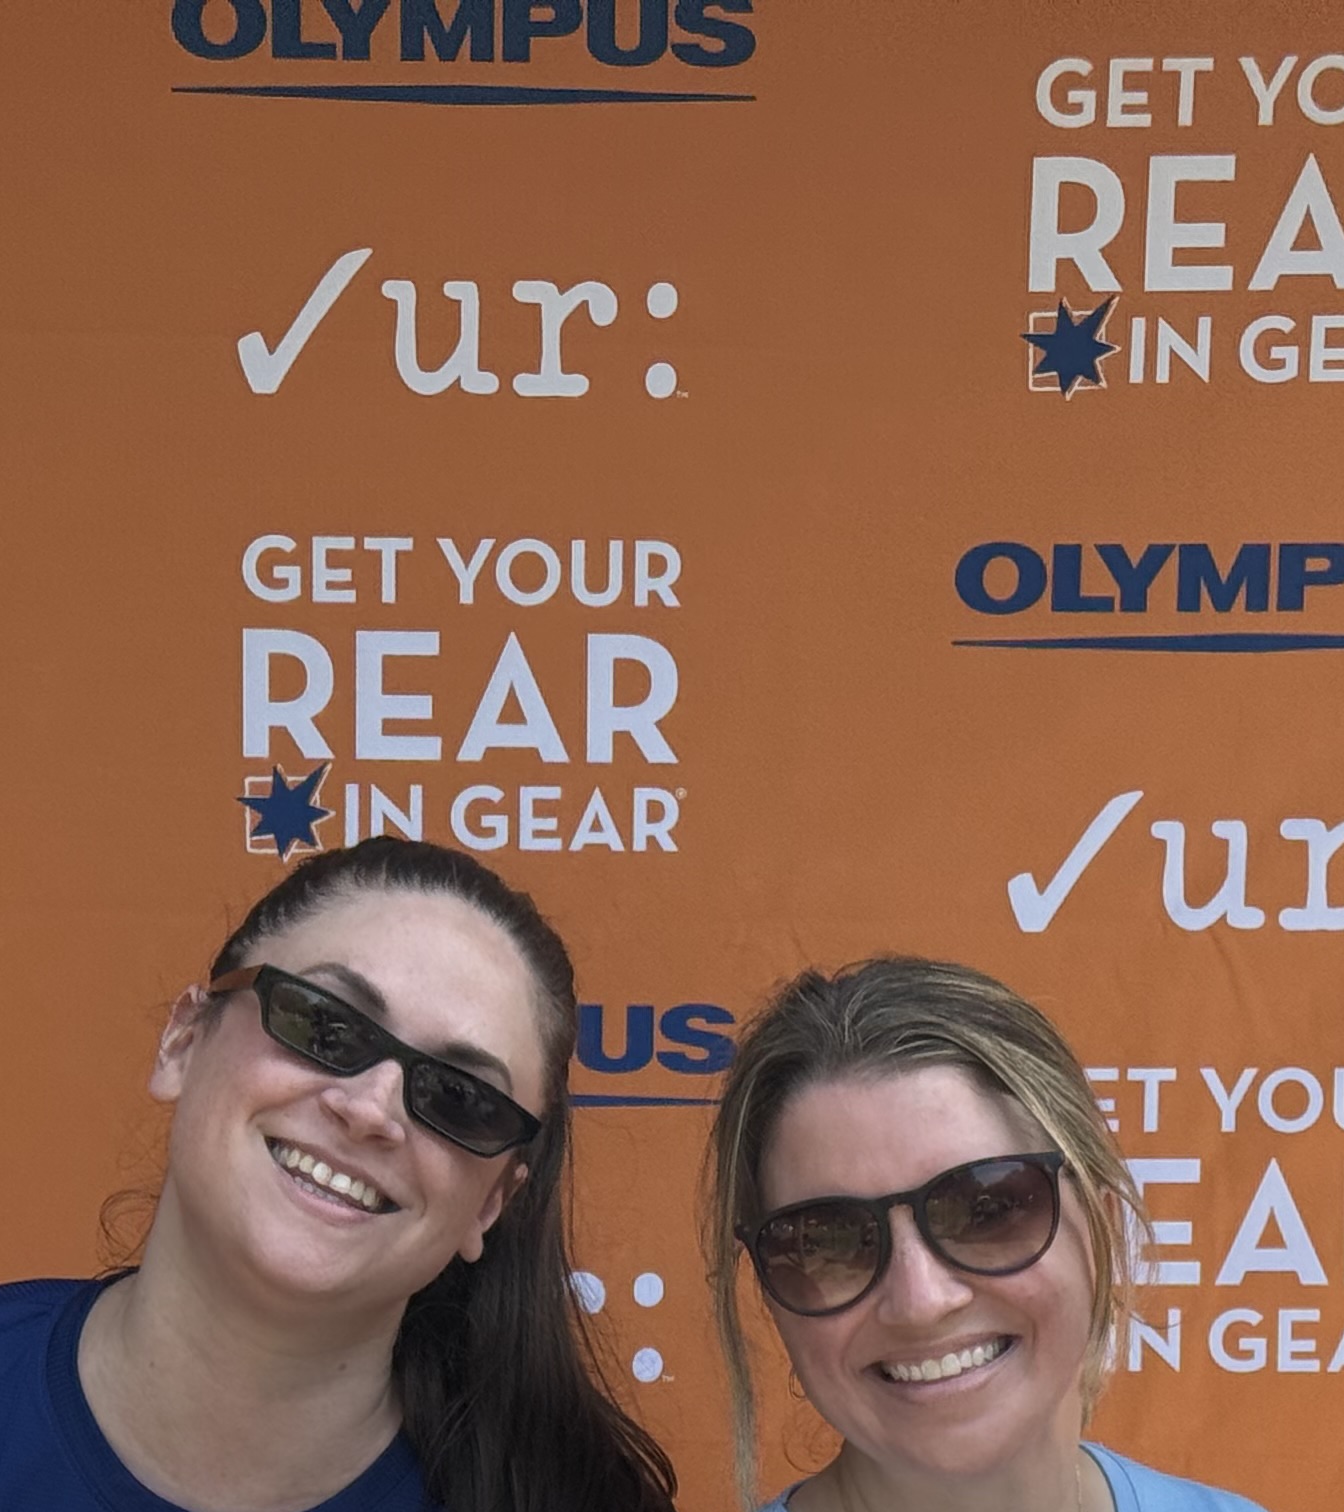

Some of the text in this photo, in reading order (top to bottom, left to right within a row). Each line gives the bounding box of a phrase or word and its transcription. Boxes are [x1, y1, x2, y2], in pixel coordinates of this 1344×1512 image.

[172, 0, 757, 68] OLYMPUS
[1035, 57, 1214, 129] GET
[1129, 316, 1212, 384] IN
[242, 534, 682, 607] GET YOUR
[242, 628, 680, 764] REAR
[344, 783, 679, 852] IN GEAR
[1084, 1067, 1176, 1132] ET
